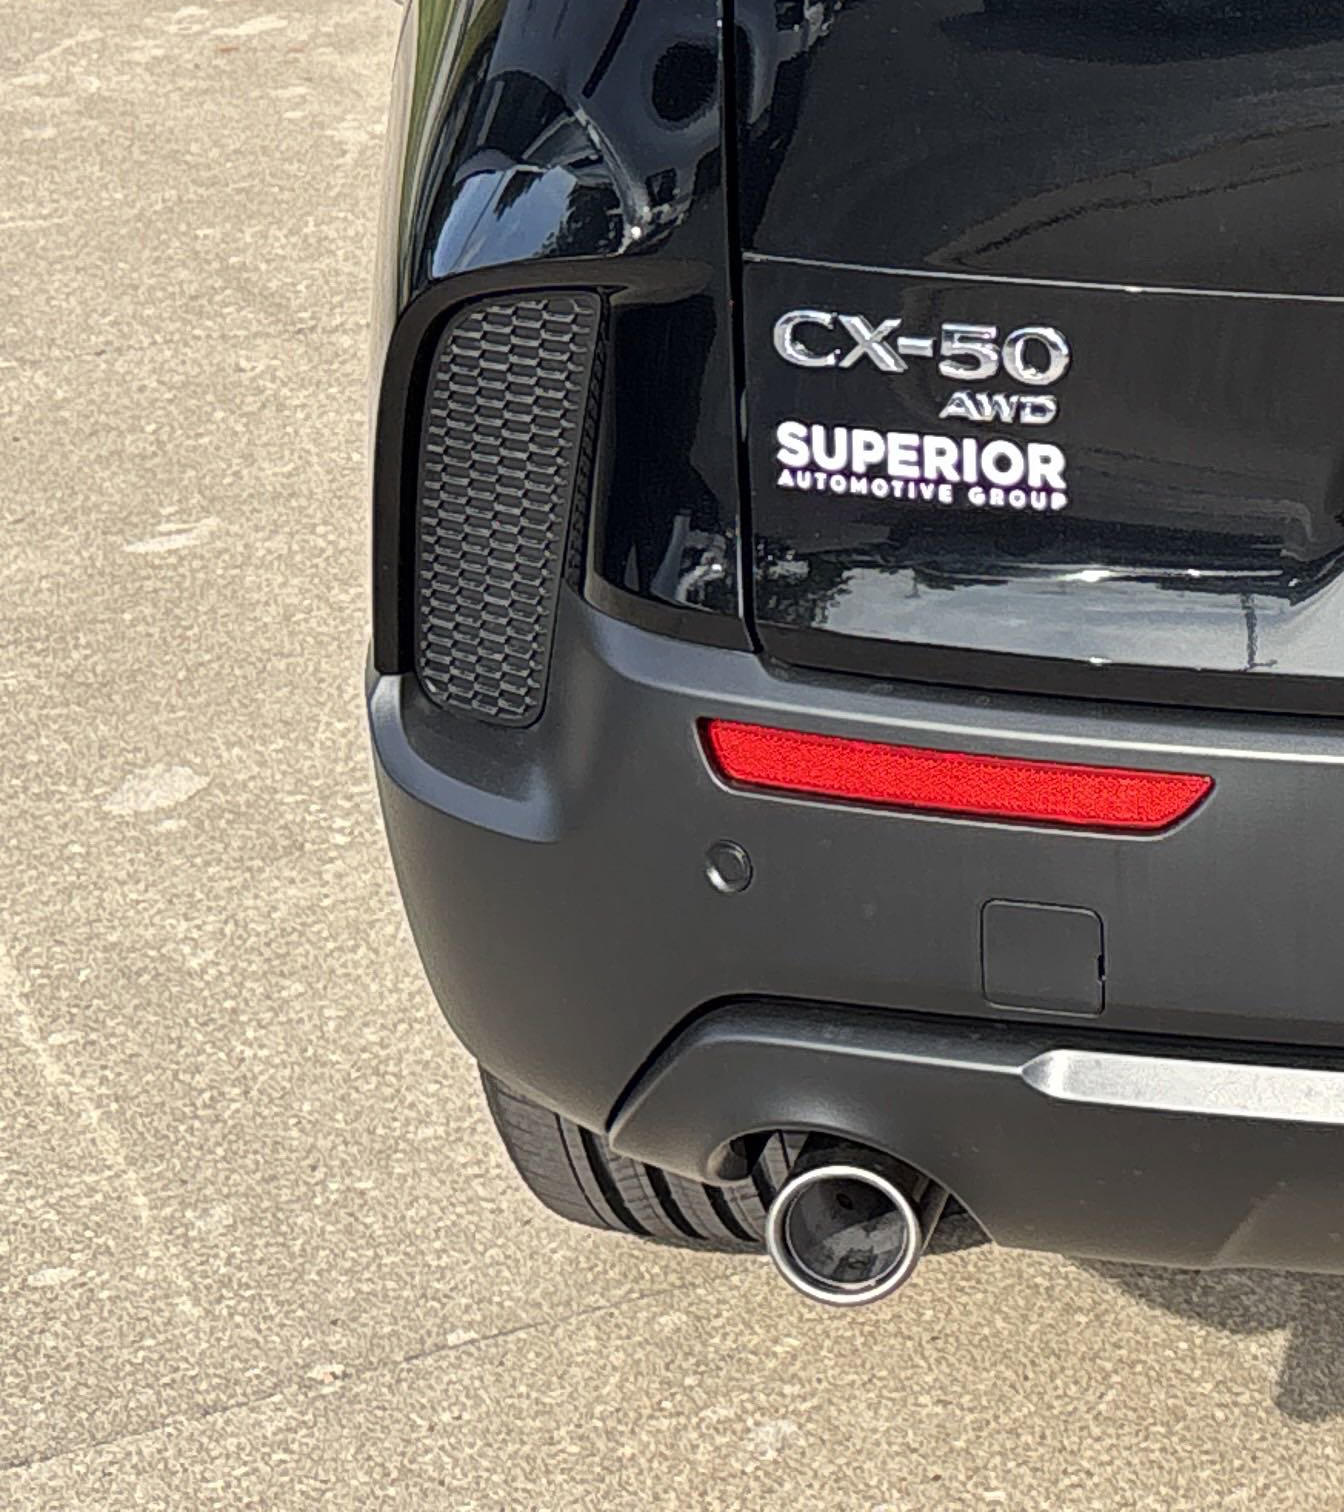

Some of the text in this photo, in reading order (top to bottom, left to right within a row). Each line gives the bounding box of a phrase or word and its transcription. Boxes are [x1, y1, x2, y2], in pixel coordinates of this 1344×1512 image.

[773, 308, 1071, 386] CX-50
[938, 390, 1060, 425] AWD
[776, 420, 1067, 489] SUPERIOR
[777, 468, 1068, 511] AUTOMOTIVE GROUP
